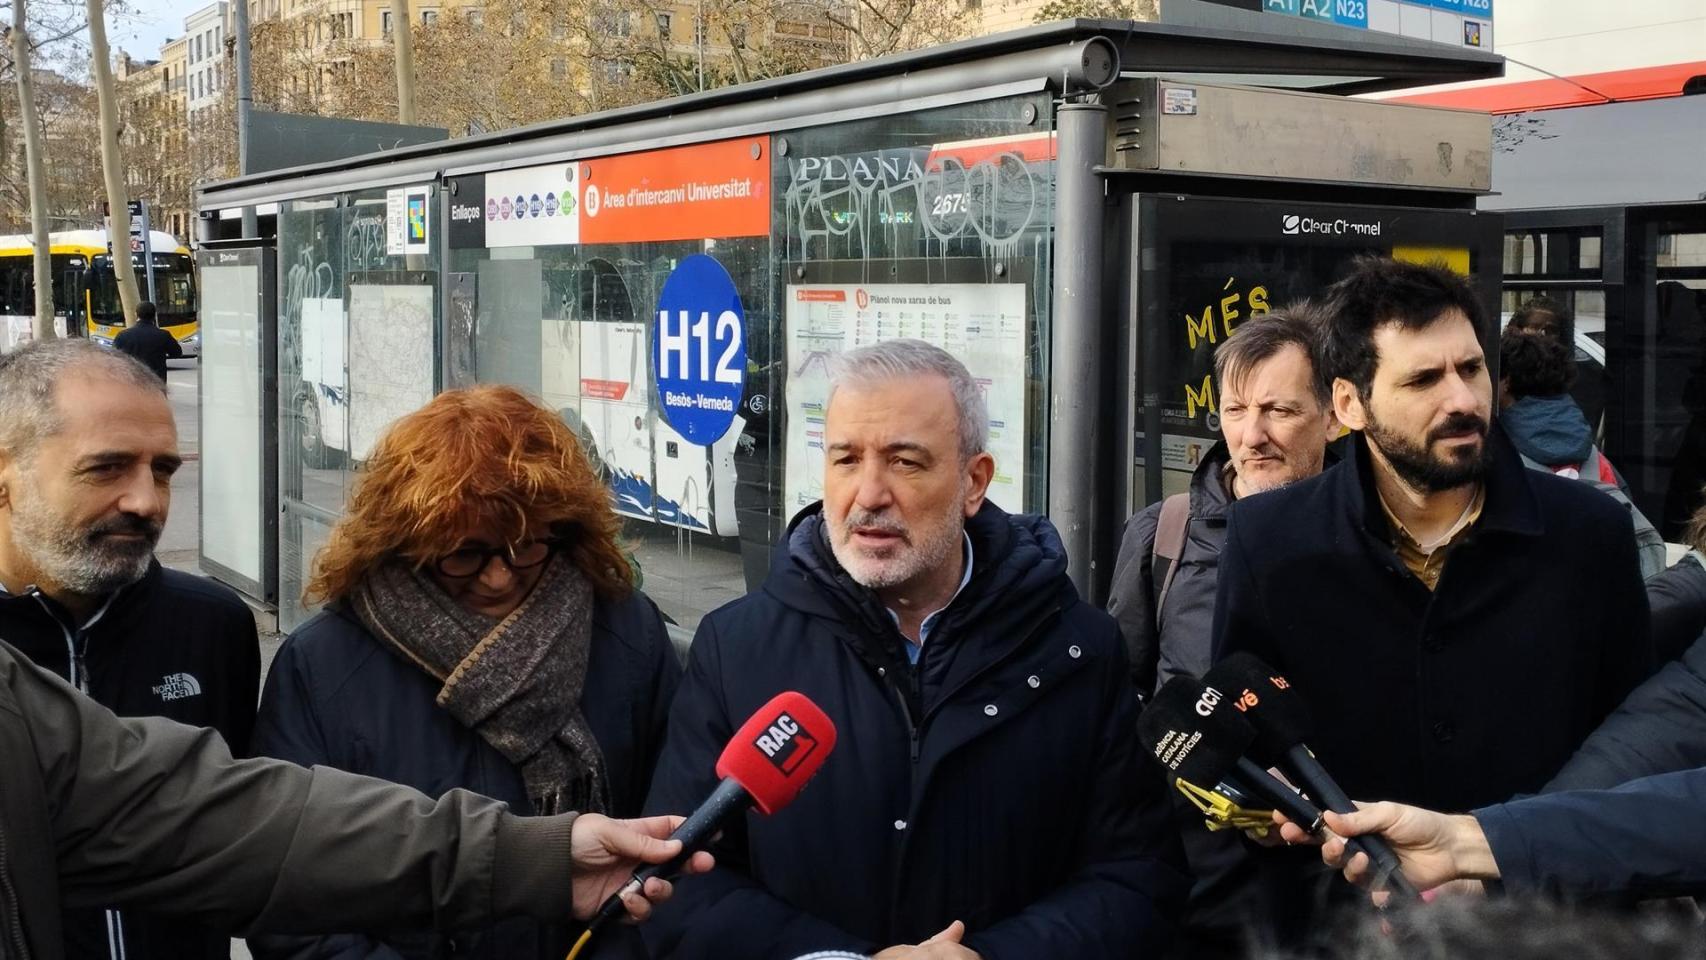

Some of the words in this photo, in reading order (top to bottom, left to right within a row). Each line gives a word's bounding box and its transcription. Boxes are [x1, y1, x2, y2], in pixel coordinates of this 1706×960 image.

[1302, 0, 1330, 18] A2
[1336, 0, 1365, 20] N23
[798, 157, 924, 181] PLANA
[603, 187, 625, 208] Àrea
[626, 183, 686, 206] d'intercanvi
[687, 177, 751, 202] Universitat
[451, 205, 480, 223] Enllaços
[1185, 277, 1273, 349] MÉS
[659, 310, 742, 384] H12
[152, 681, 183, 695] NORTH
[162, 673, 182, 685] THE
[161, 690, 185, 702] FACE
[1195, 686, 1223, 717] acn
[755, 714, 799, 758] RAC
[1161, 731, 1189, 763] CATALANA
[1169, 759, 1180, 770] DE
